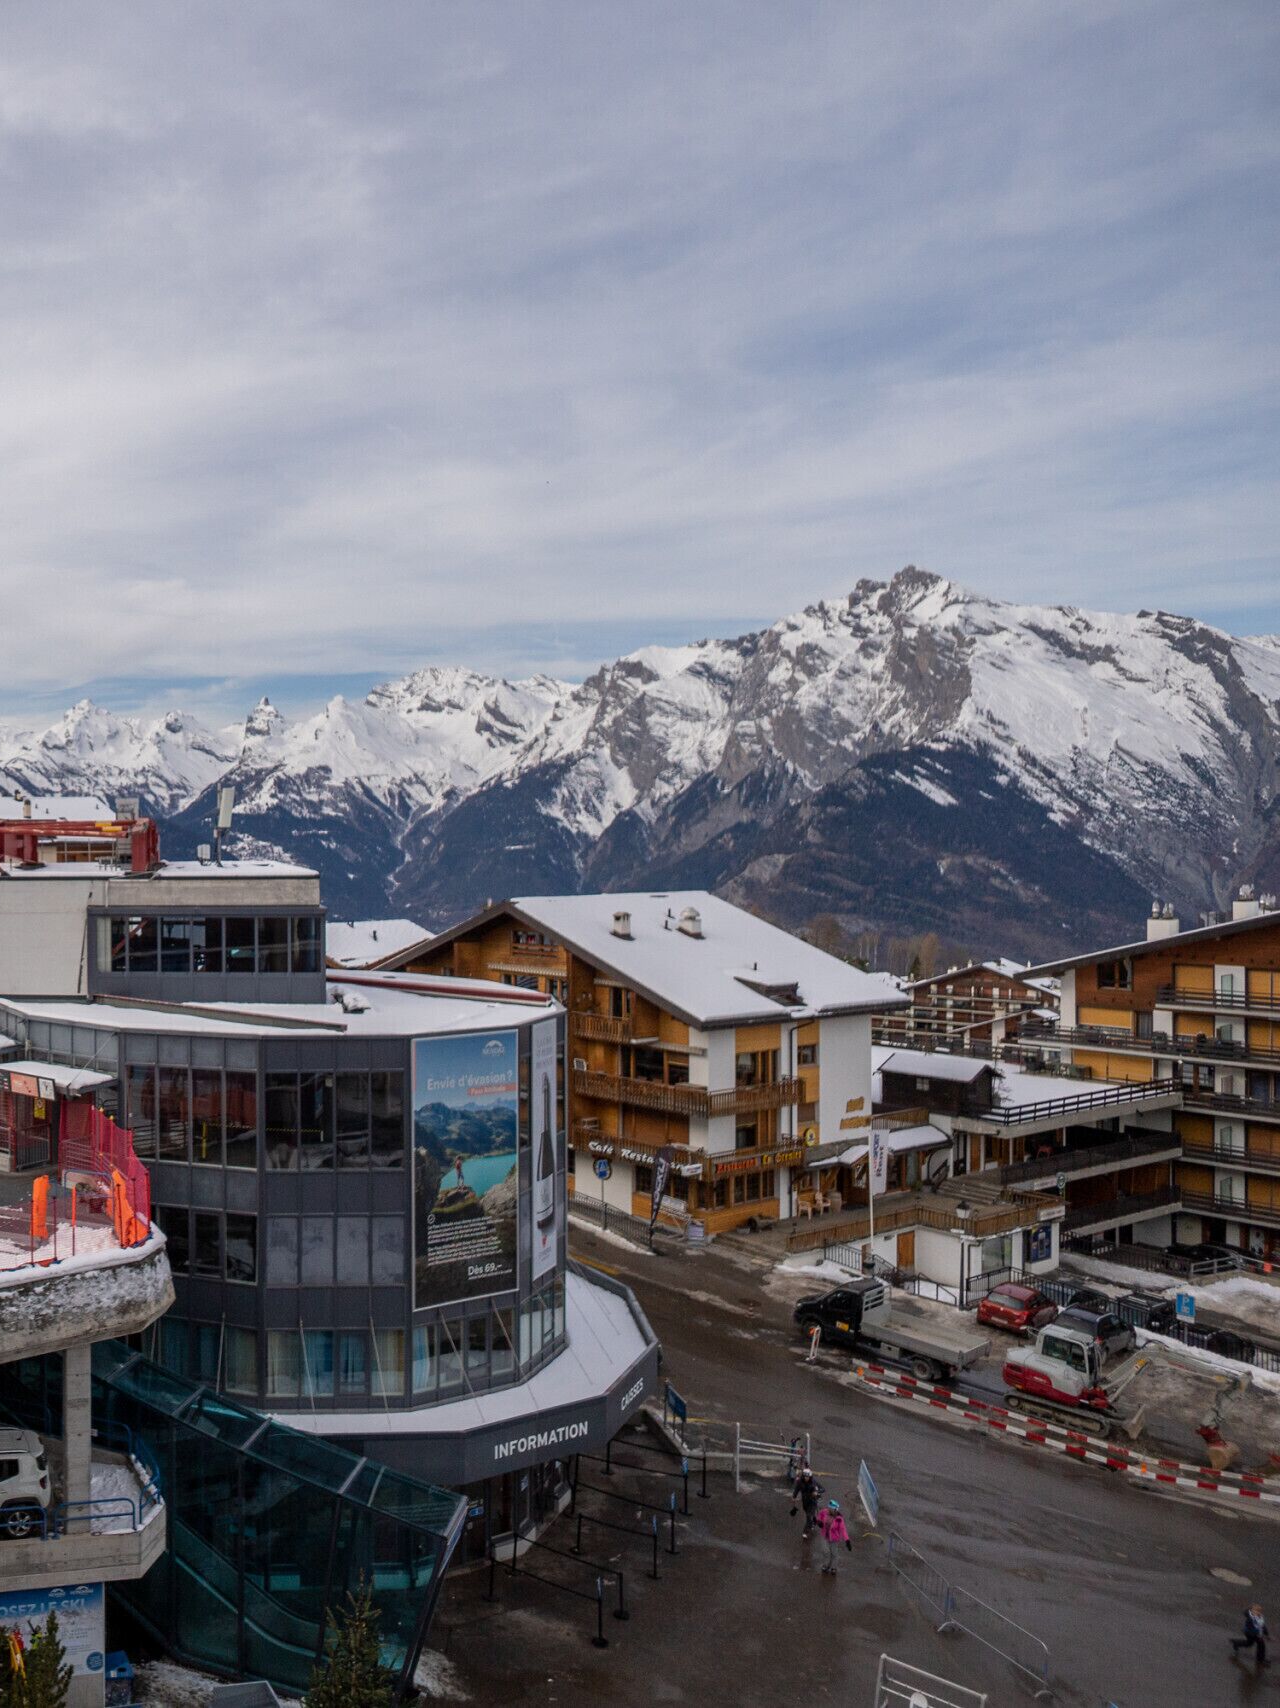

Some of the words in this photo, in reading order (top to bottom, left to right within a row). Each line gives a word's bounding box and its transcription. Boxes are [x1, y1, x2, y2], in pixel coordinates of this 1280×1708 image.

[427, 1077, 456, 1091] Envie
[588, 1141, 614, 1155] Café
[467, 1264, 483, 1276] Dès
[620, 1377, 644, 1411] CAISSES
[494, 1420, 589, 1460] INFORMATION
[60, 1598, 86, 1611] SKI
